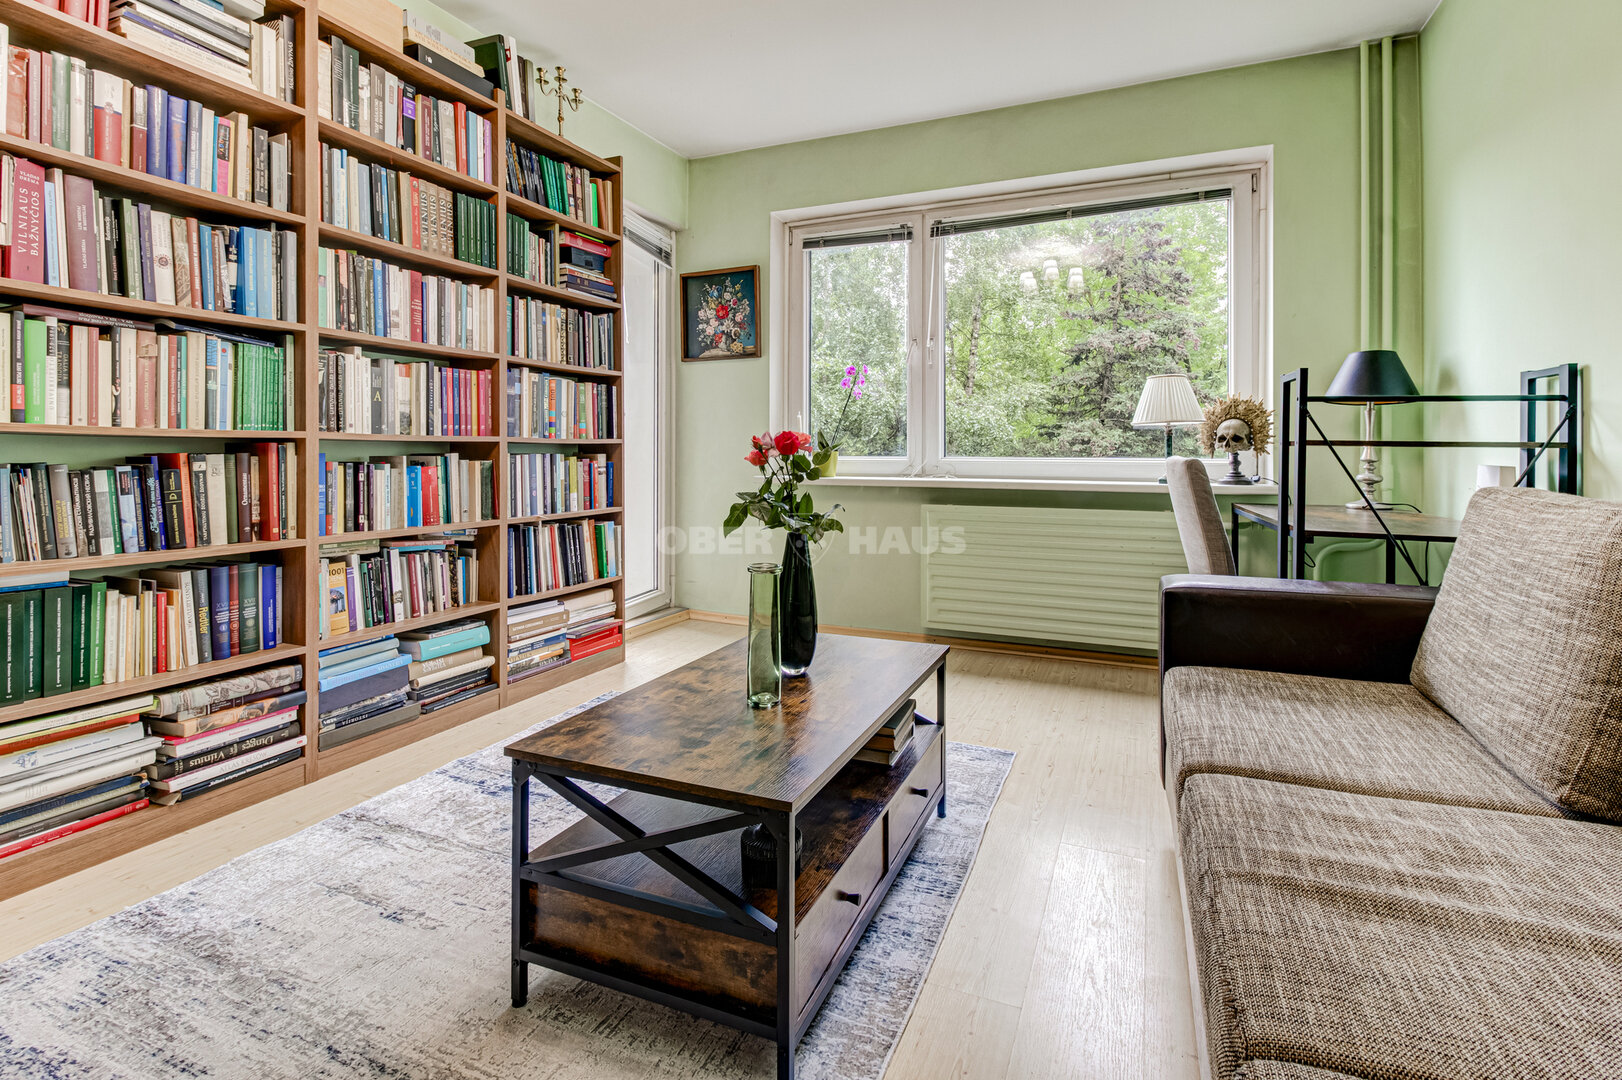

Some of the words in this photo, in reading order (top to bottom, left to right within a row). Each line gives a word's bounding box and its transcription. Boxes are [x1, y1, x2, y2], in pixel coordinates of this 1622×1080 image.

[19, 170, 40, 181] VLADAS
[18, 187, 28, 254] VILNIAUS
[29, 190, 40, 256] BAŽNYČIOS
[342, 714, 368, 726] ISTORIJA
[189, 750, 225, 767] Vilnius
